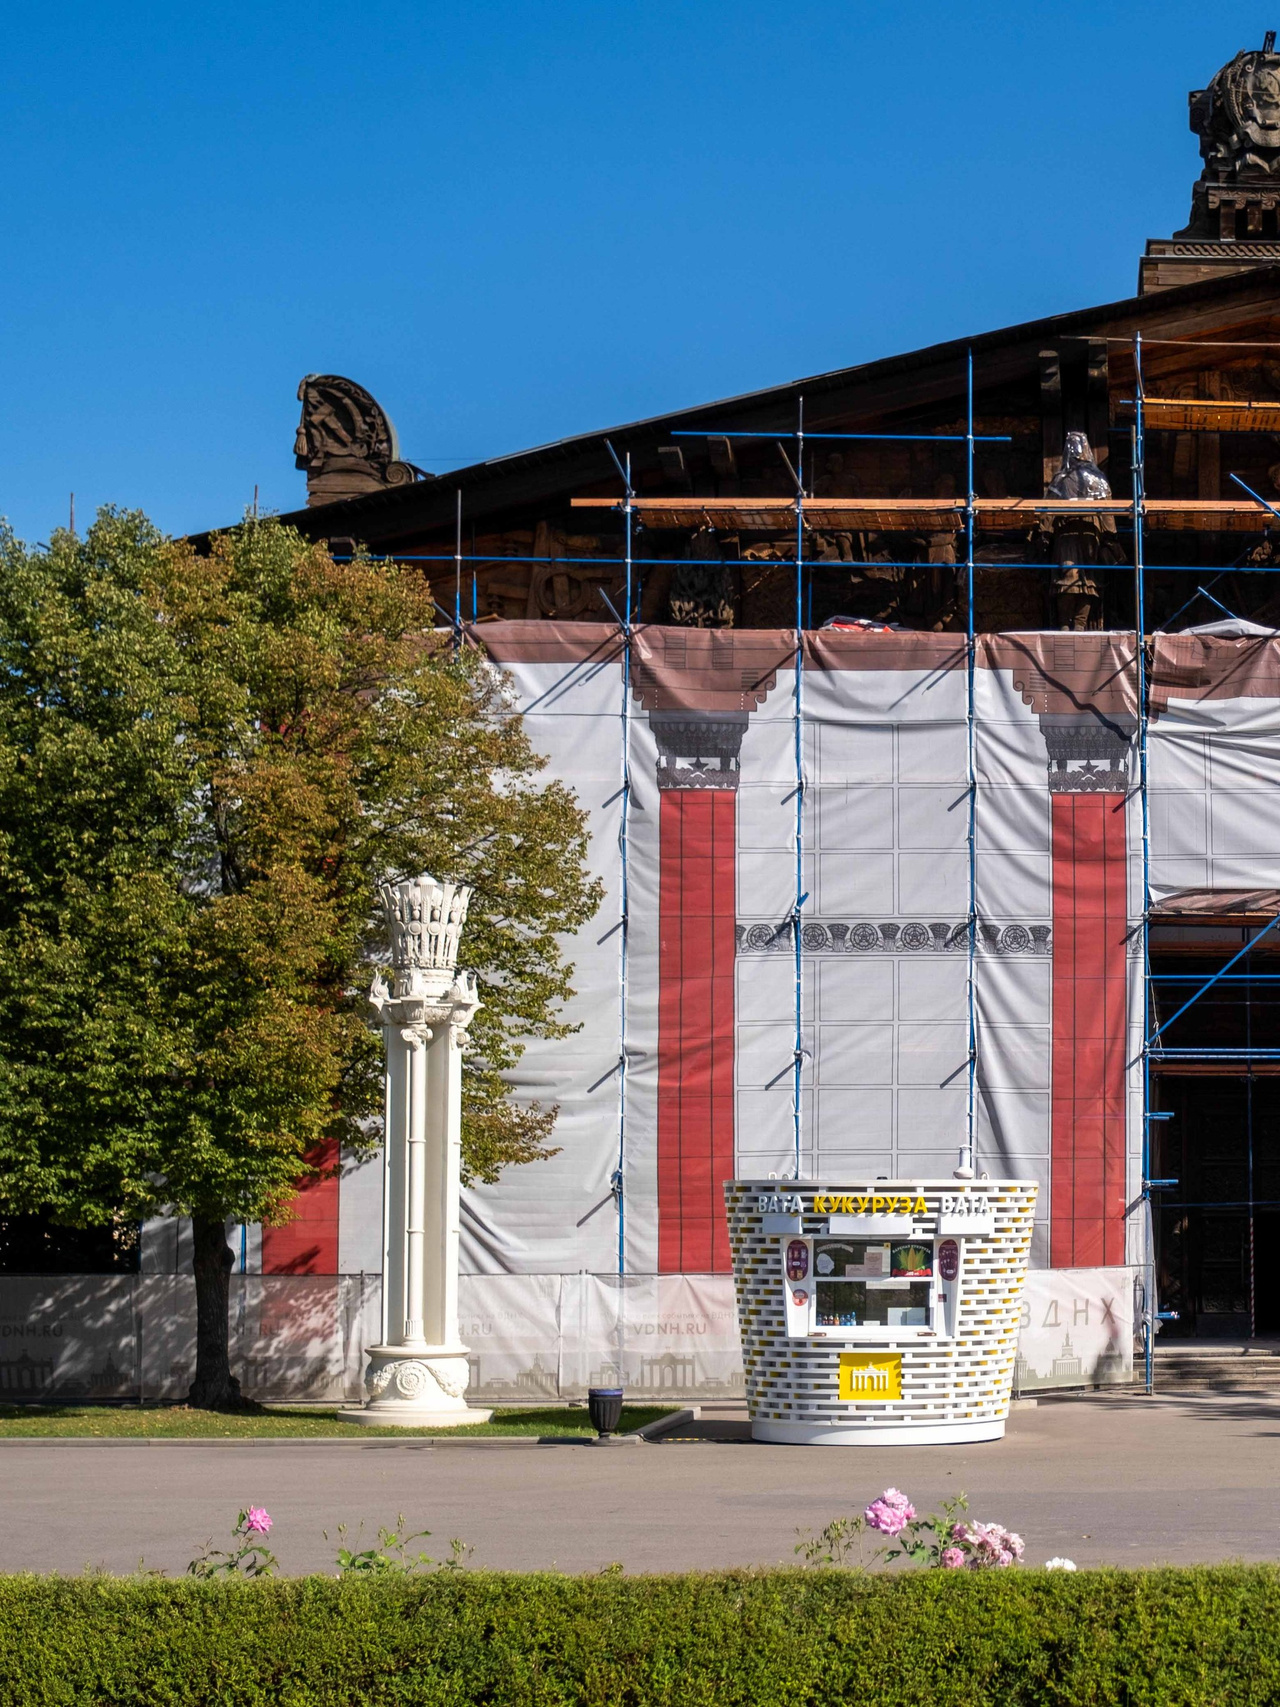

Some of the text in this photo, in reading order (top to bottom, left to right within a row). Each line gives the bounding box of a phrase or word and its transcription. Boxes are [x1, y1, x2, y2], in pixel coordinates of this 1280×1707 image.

[758, 1195, 991, 1213] ВАТА КУКУРУЗА ВАТА
[0, 1323, 63, 1338] DNH.RU
[632, 1322, 707, 1335] VDNH.RU
